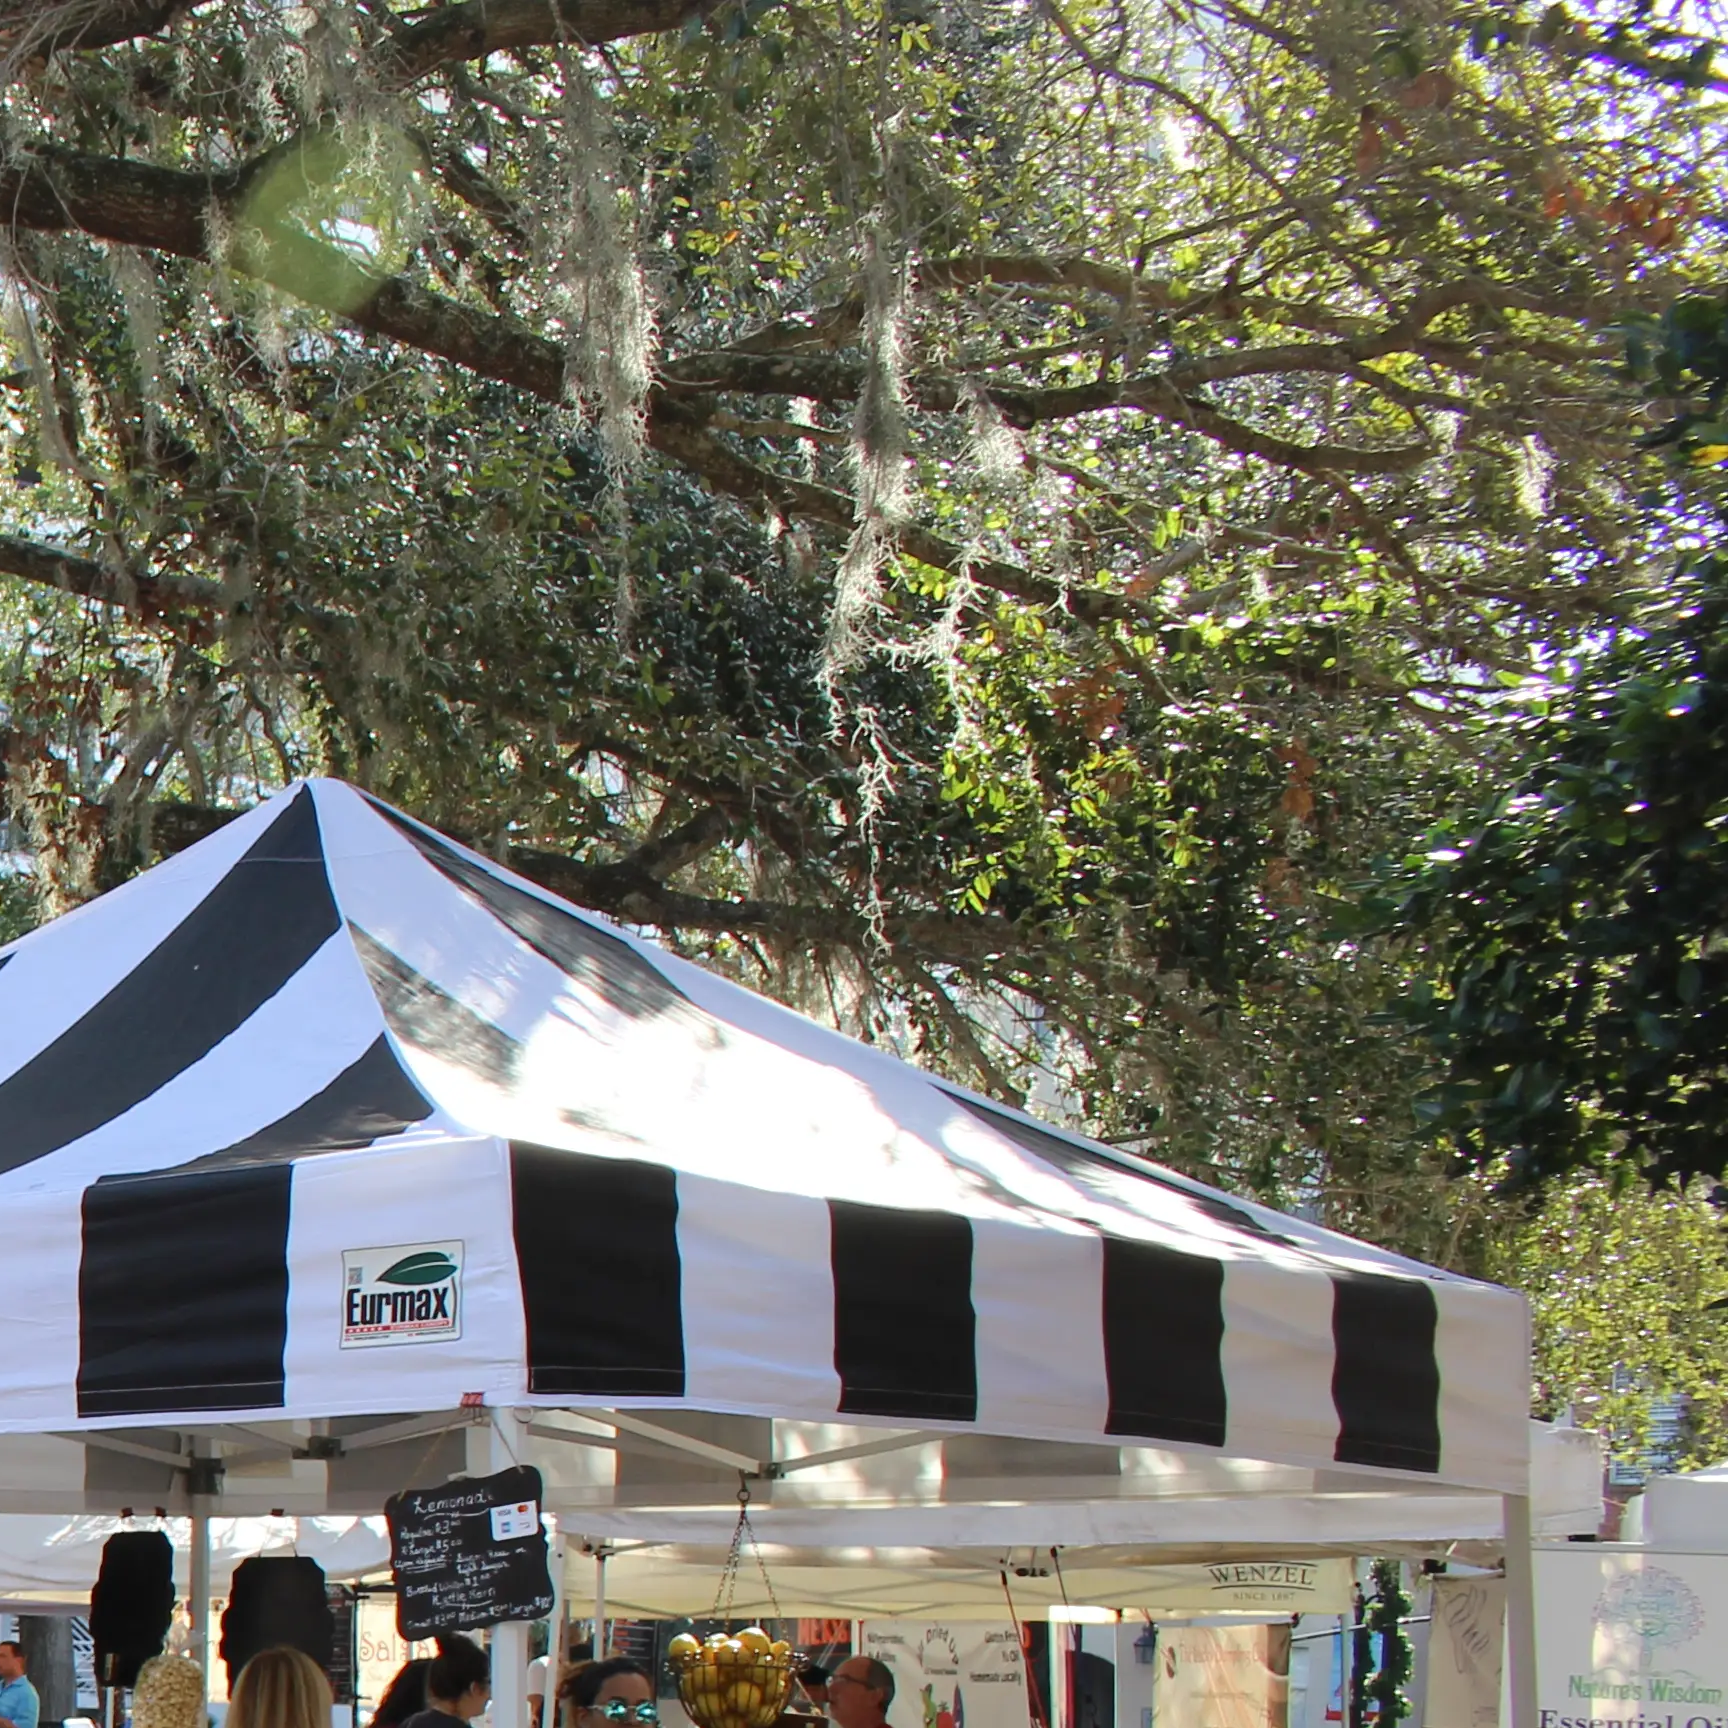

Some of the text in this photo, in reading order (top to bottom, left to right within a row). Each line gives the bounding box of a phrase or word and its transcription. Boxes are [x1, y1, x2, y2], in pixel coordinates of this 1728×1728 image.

[346, 1287, 449, 1327] Eurmax
[1208, 1565, 1314, 1585] WENZEL
[1567, 1674, 1723, 1707] Nature's Wisdom
